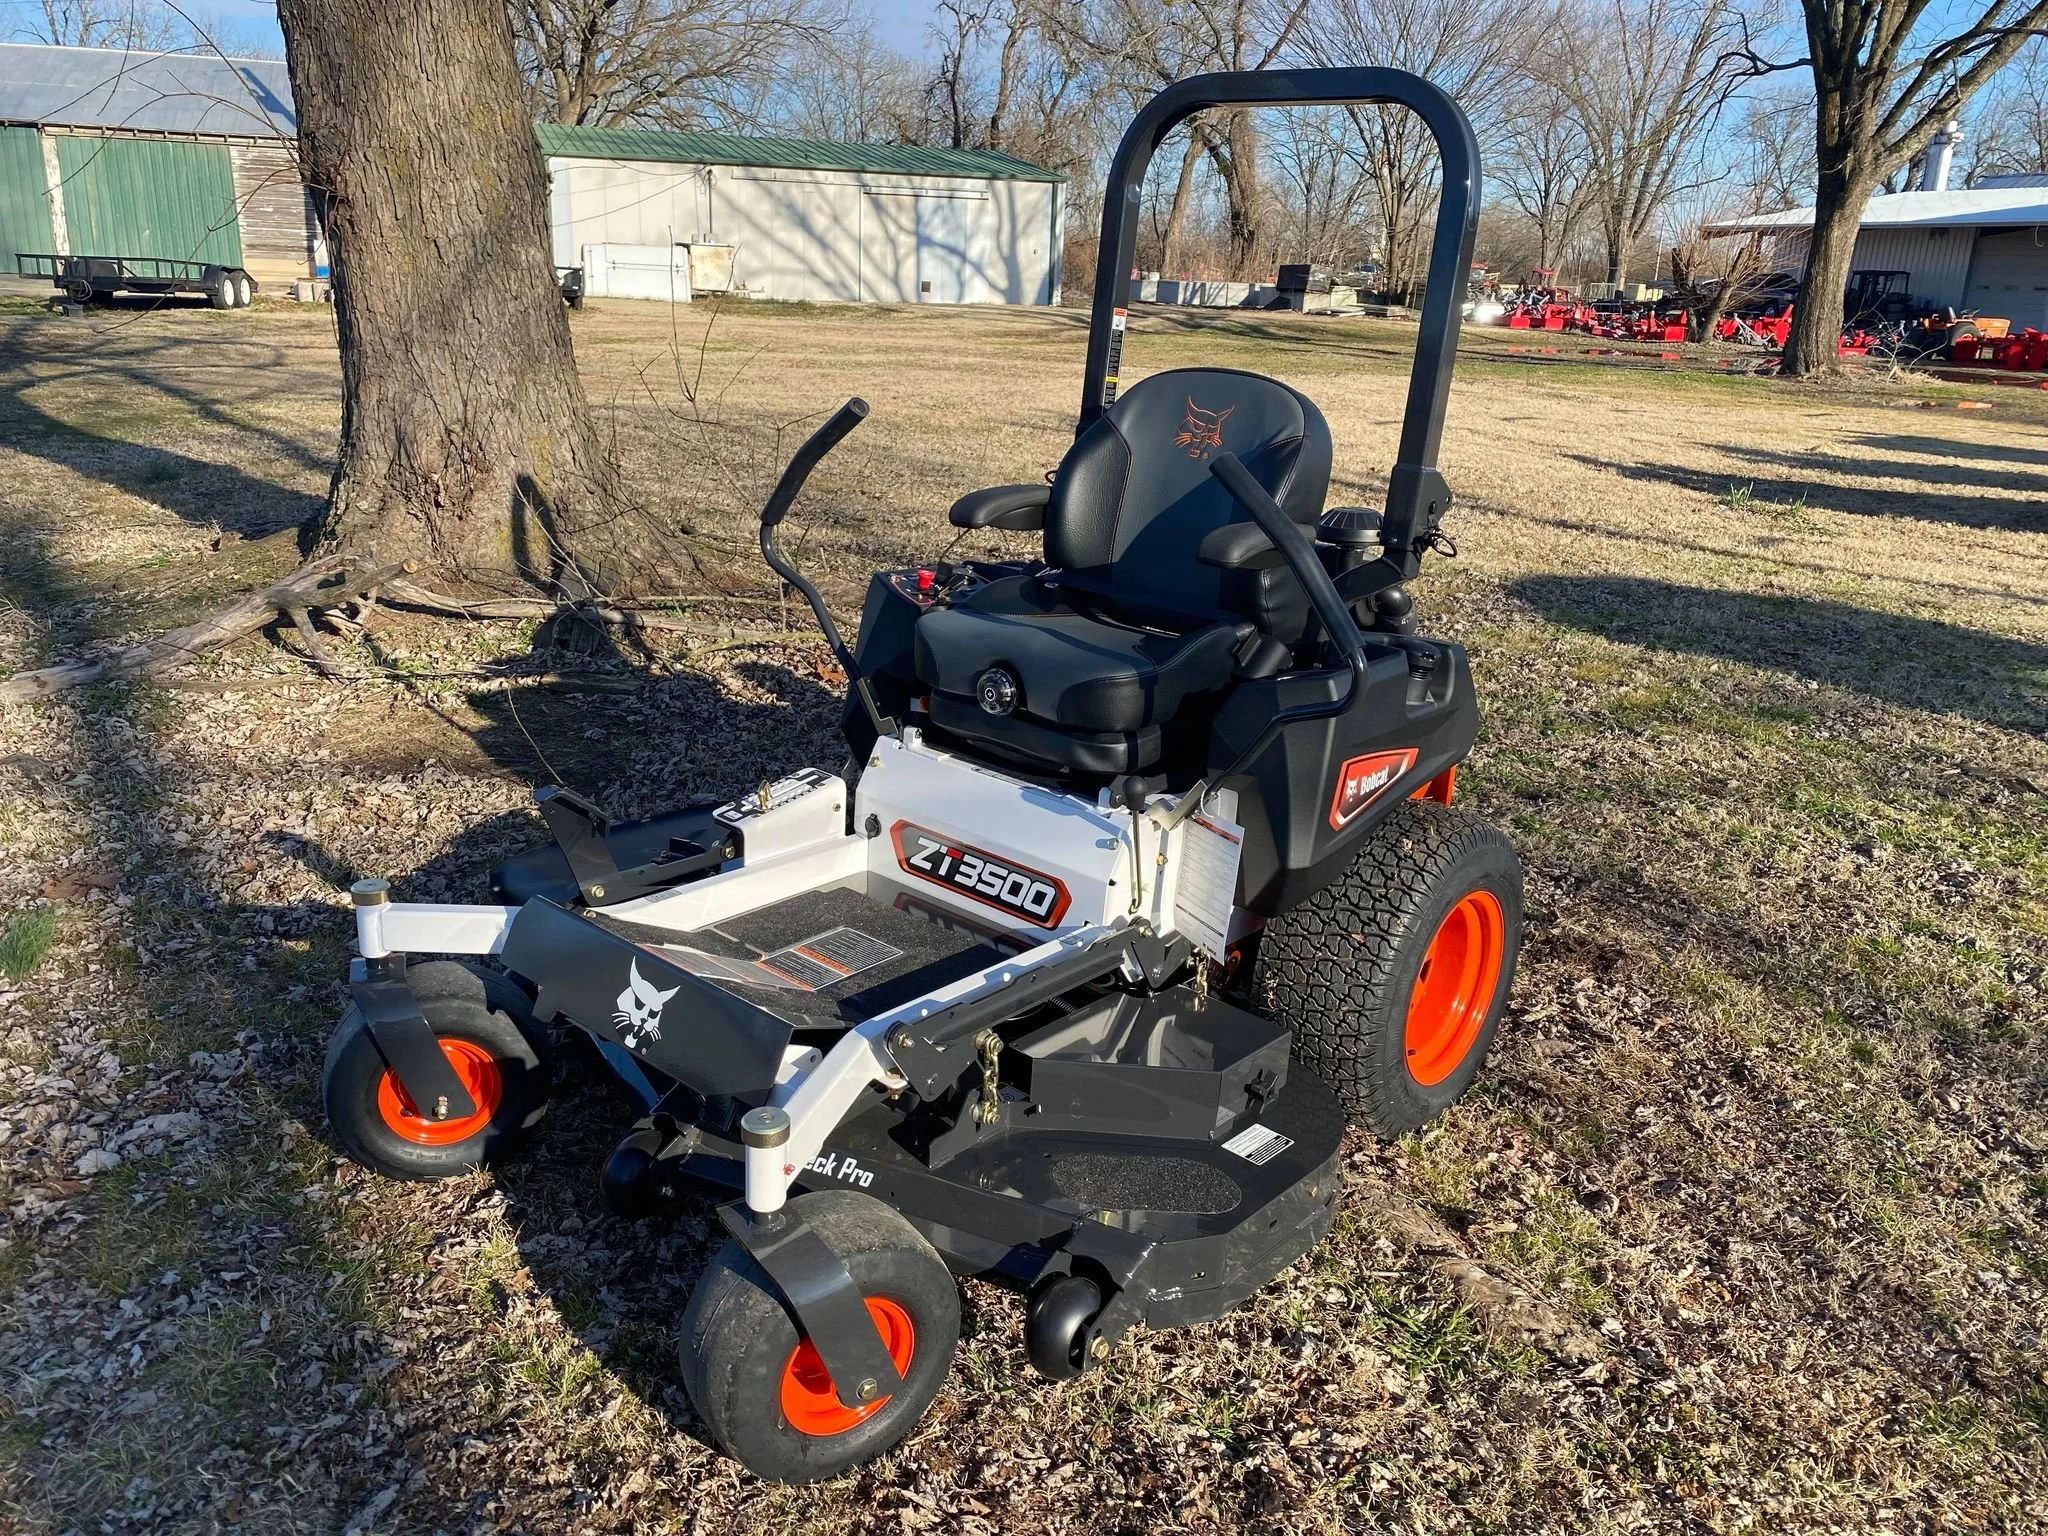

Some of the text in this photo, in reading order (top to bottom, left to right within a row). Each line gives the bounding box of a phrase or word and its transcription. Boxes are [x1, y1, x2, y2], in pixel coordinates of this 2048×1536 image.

[1360, 765, 1390, 796] Bobcat
[909, 836, 1056, 917] ZT3500
[837, 1157, 875, 1188] Pro
